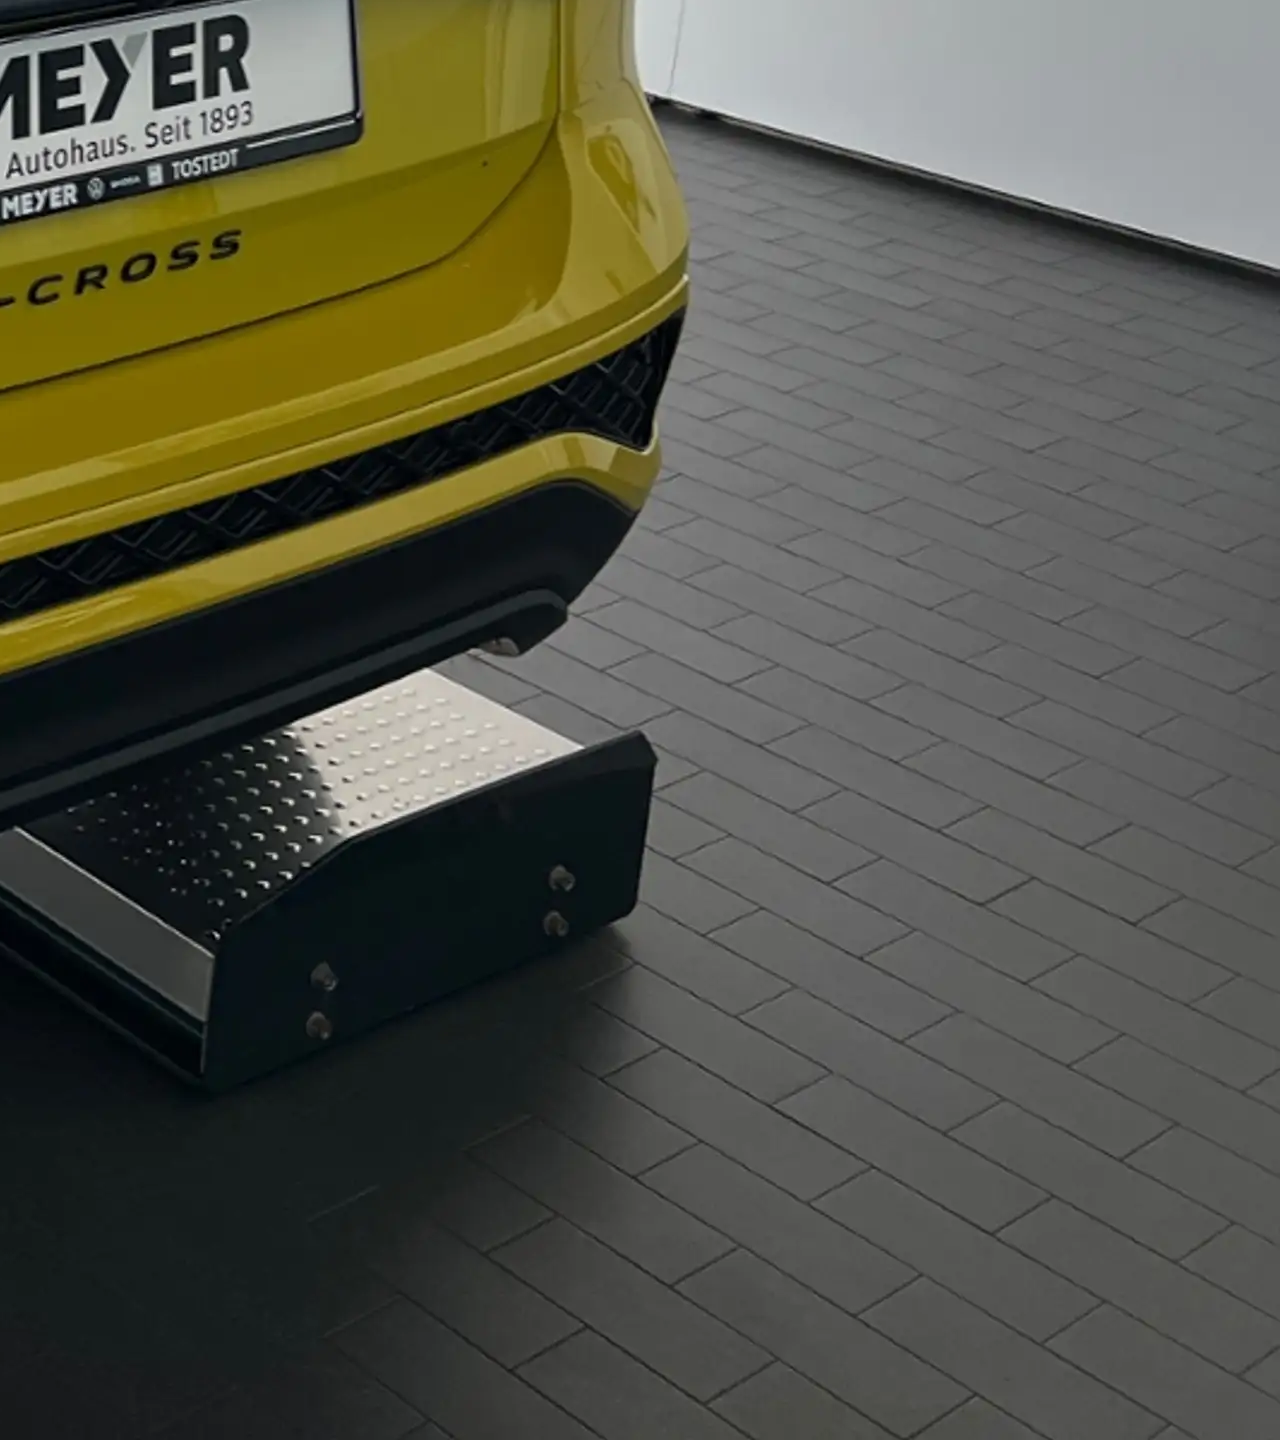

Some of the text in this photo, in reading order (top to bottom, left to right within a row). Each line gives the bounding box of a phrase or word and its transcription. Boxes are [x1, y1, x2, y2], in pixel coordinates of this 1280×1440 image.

[7, 136, 135, 180] Autohaus.
[144, 122, 192, 146] Seit
[199, 102, 253, 137] 1893
[1, 150, 238, 219] MEYER TOSTEDT
